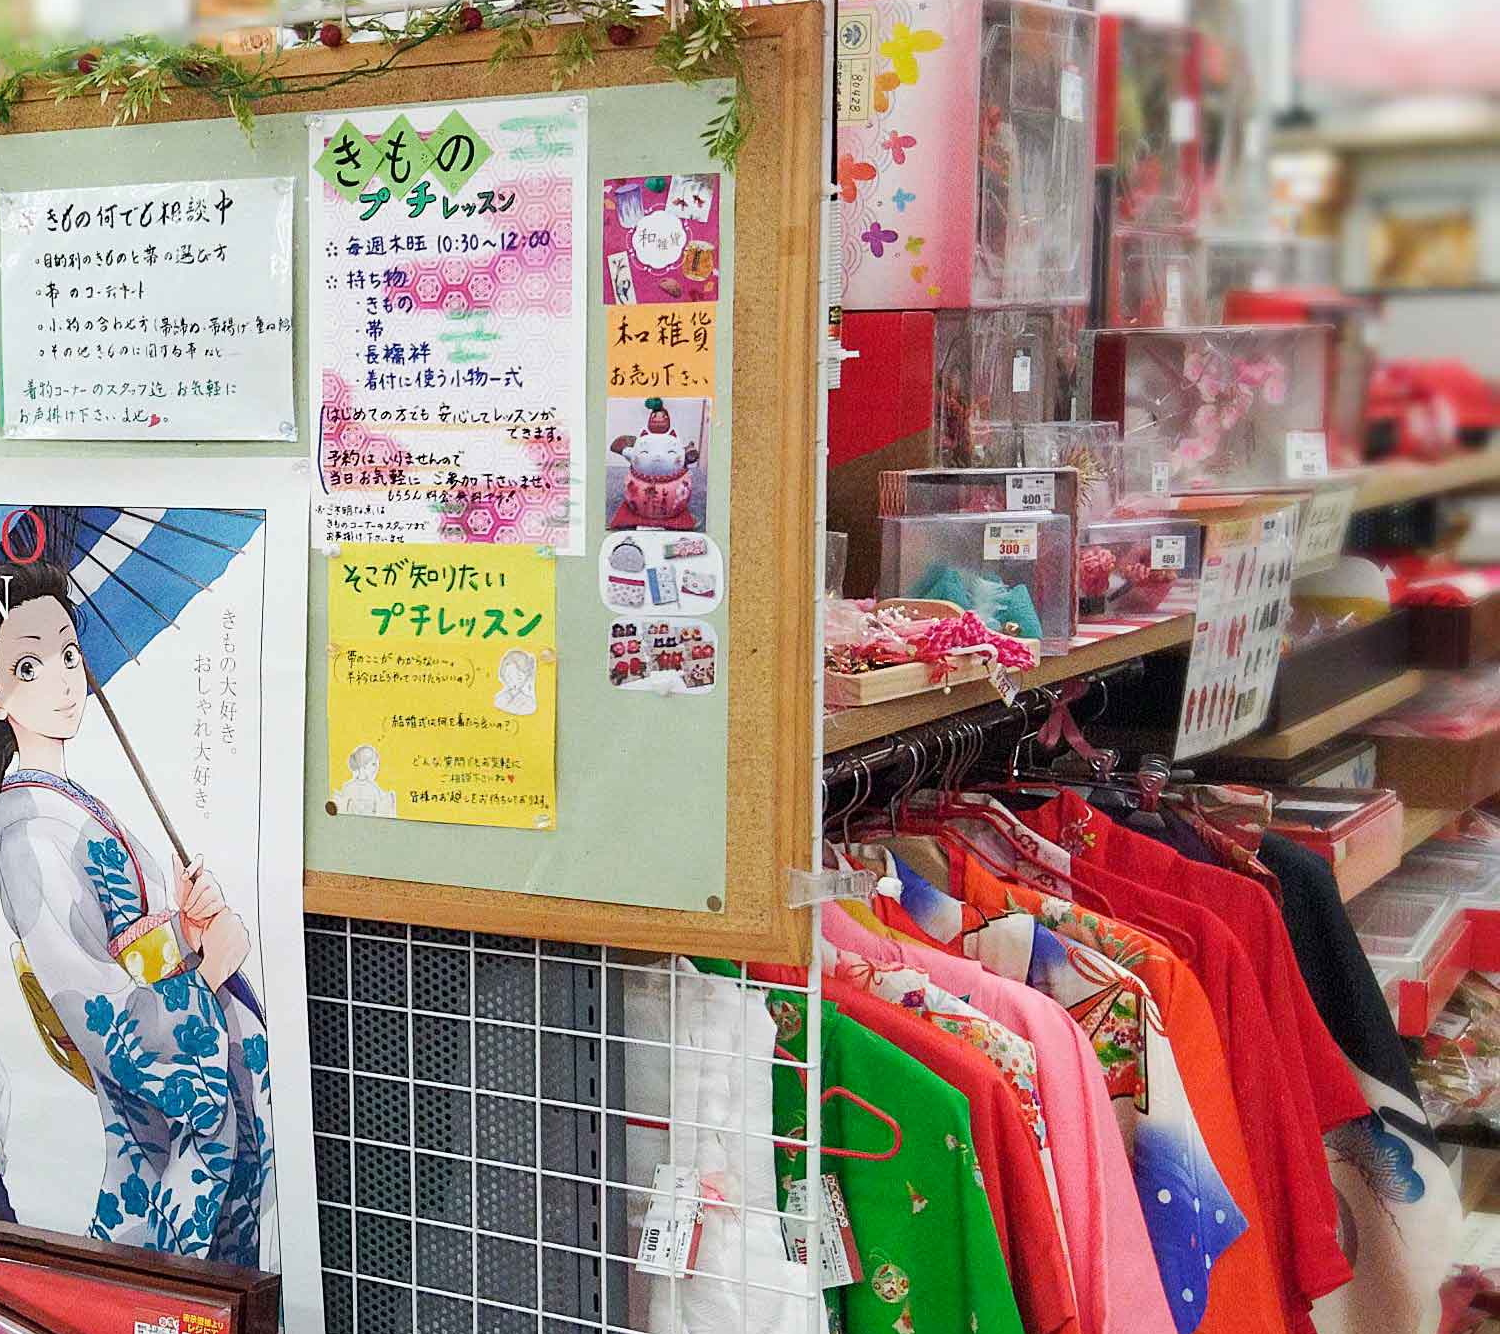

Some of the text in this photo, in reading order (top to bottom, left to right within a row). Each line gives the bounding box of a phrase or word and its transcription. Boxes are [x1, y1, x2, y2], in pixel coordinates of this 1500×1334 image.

[333, 131, 475, 187] きもの
[359, 180, 516, 221] プチレッスン
[346, 269, 408, 289] 持ち物
[366, 296, 413, 315] きもの
[365, 320, 384, 342] 帯
[614, 312, 712, 353] 和雑貨
[364, 365, 523, 389] 着付に使う小物一式
[610, 363, 709, 388] お売り下さい
[343, 557, 506, 593] そこが知りたい
[371, 603, 543, 639] プチレッスン
[219, 610, 237, 755] きもの大好き。
[193, 654, 212, 819] おしゃれ大好き。
